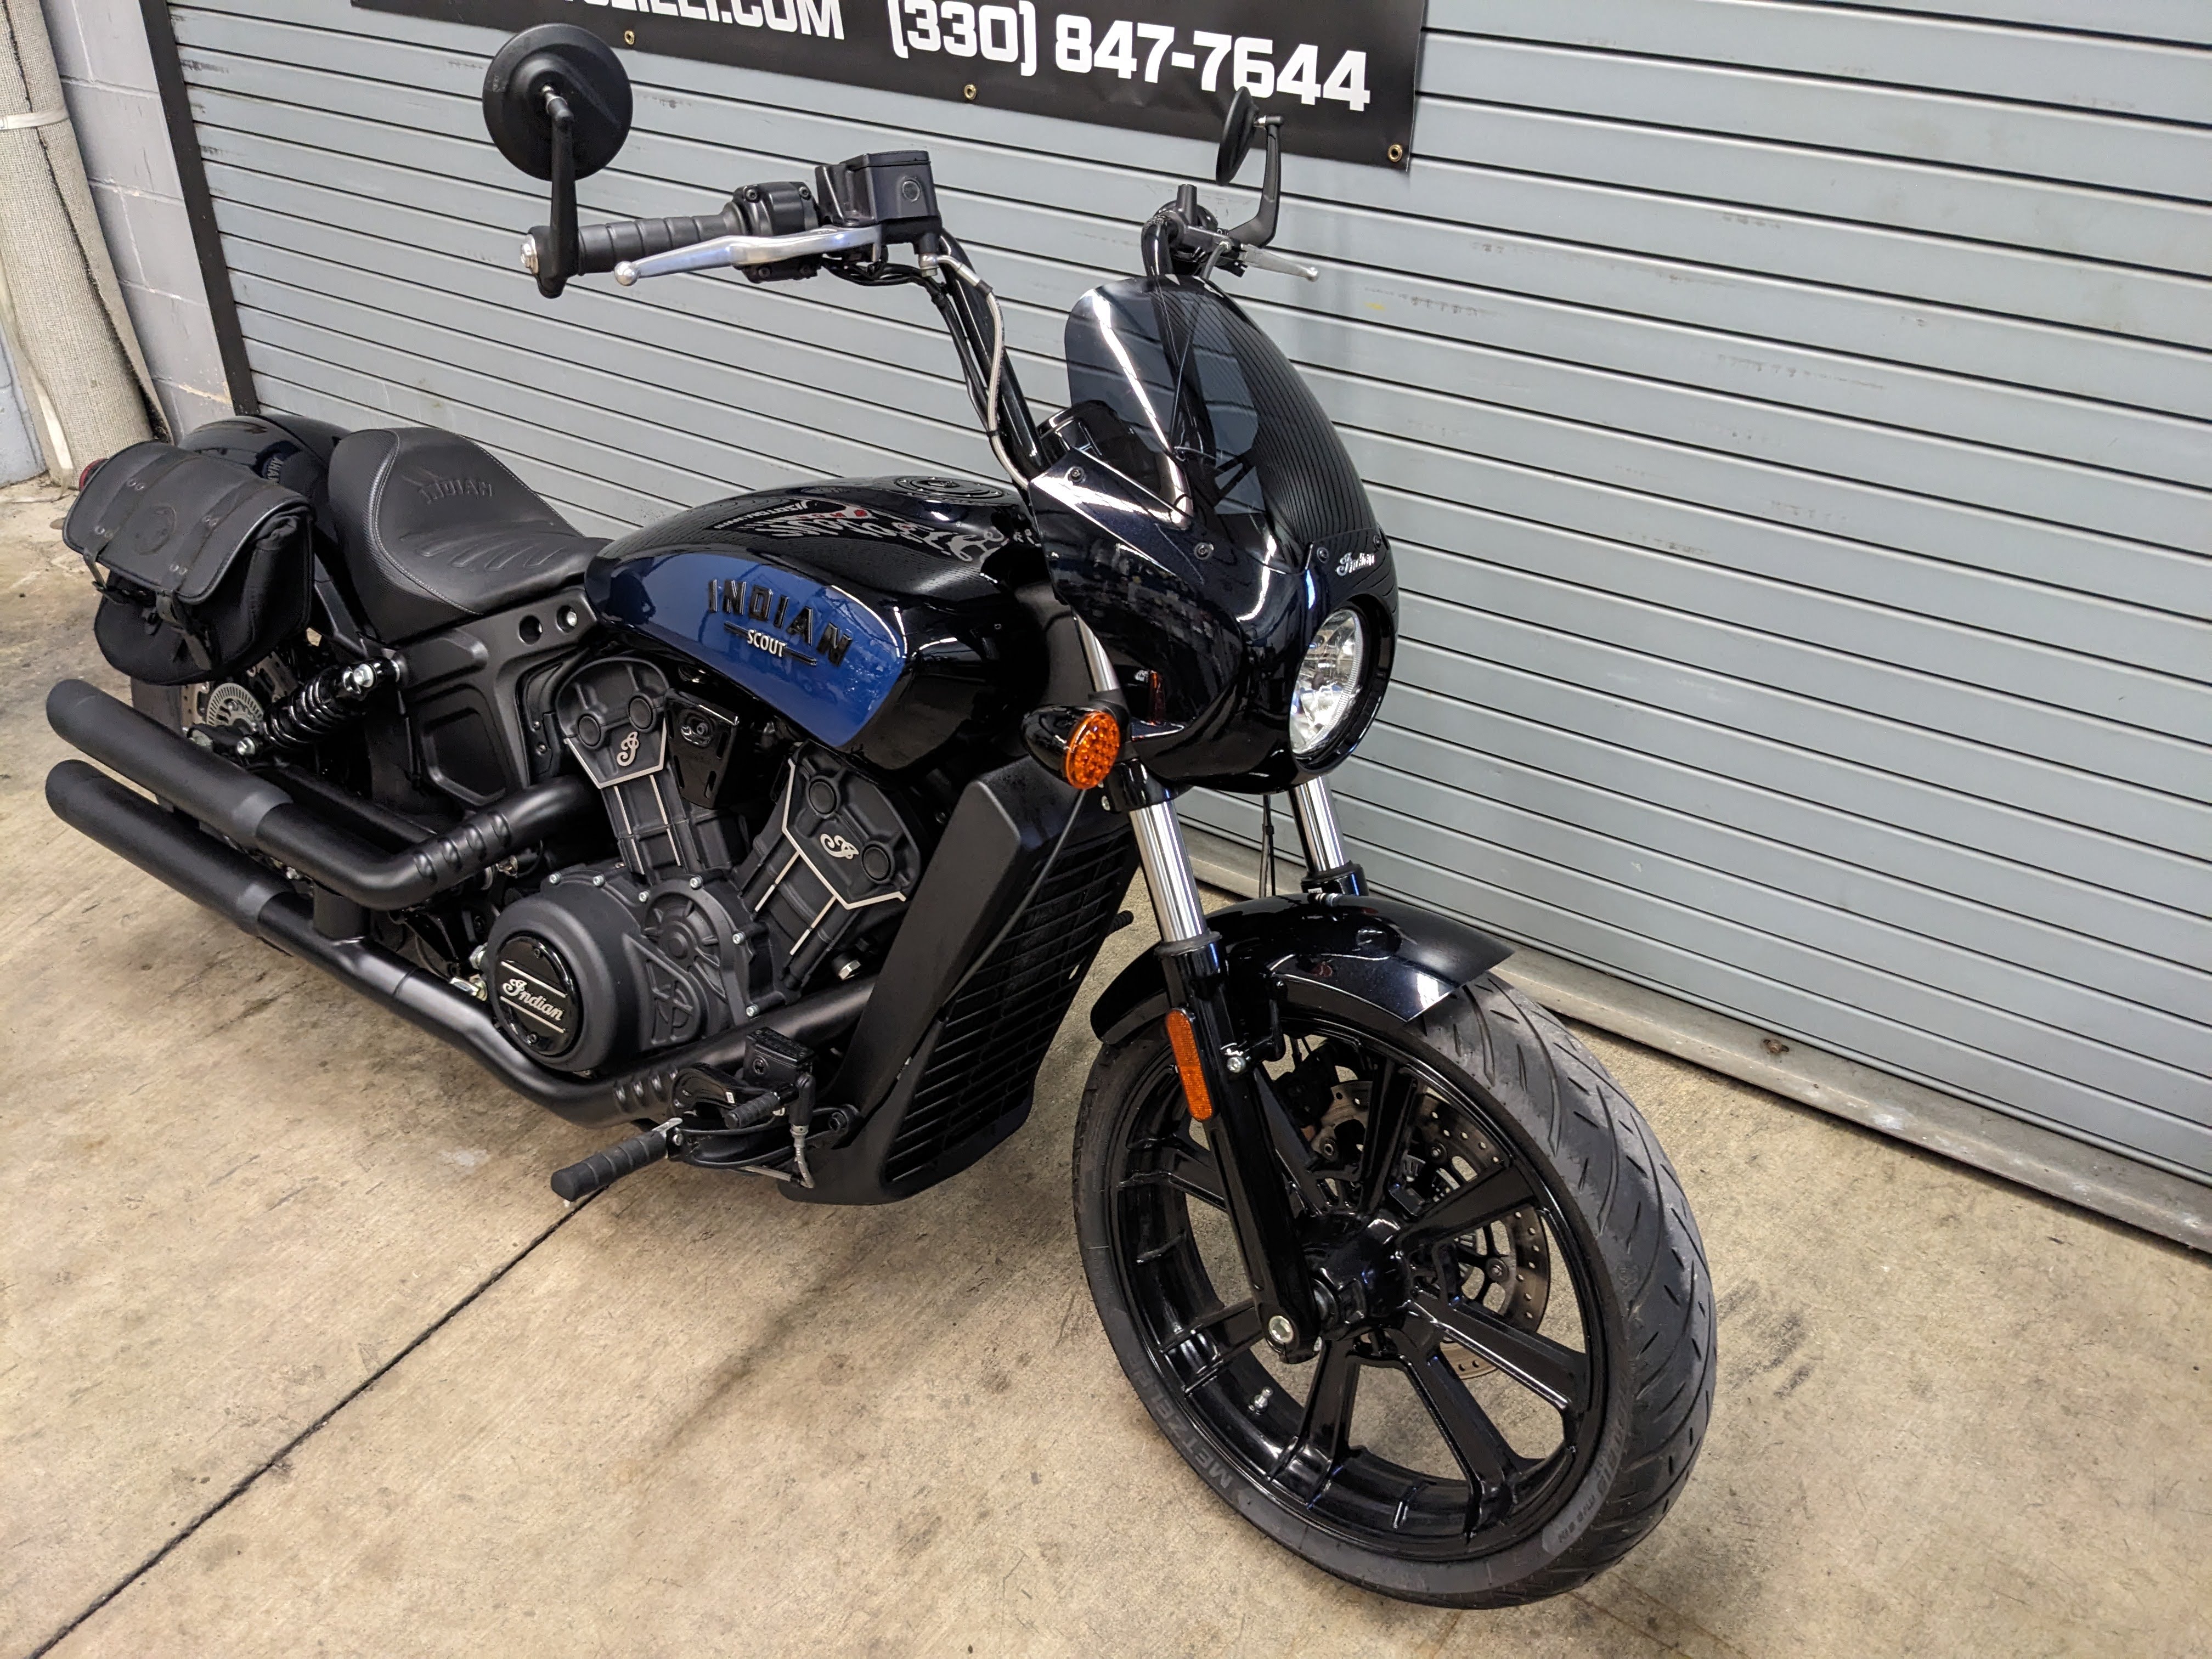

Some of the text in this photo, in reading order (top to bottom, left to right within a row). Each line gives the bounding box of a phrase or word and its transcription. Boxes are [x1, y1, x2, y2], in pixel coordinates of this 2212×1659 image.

[888, 0, 1037, 76] (330)
[1056, 14, 1370, 111] 847-7644
[1336, 552, 1376, 576] Indian
[708, 579, 853, 667] INDIAN
[747, 629, 786, 658] SCOUT
[502, 978, 564, 1021] Indian
